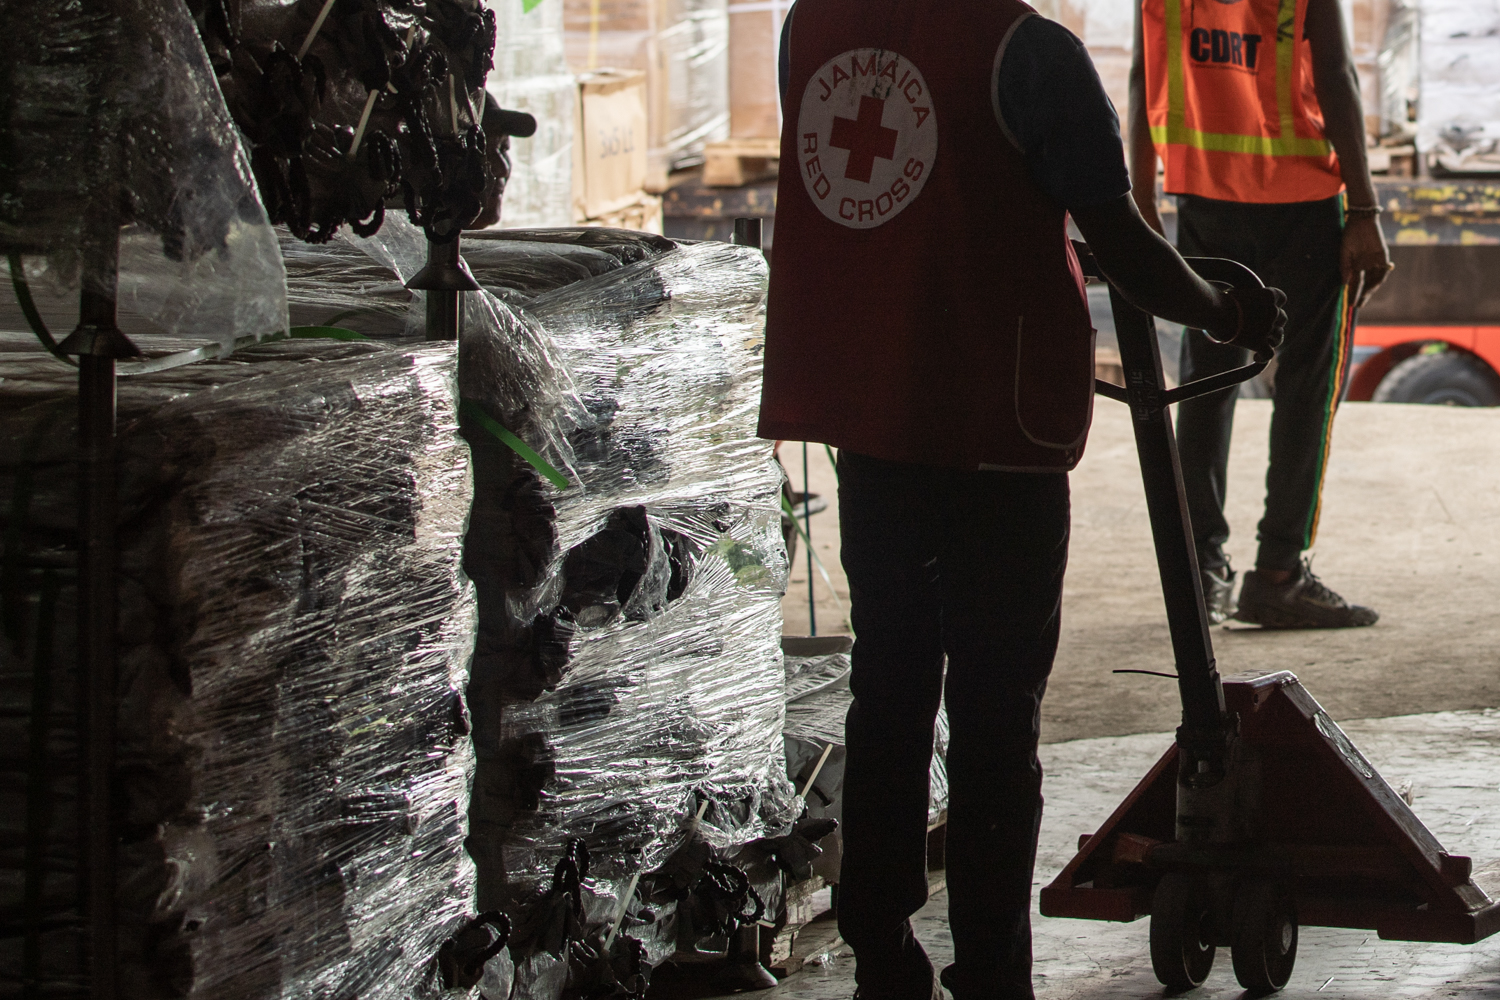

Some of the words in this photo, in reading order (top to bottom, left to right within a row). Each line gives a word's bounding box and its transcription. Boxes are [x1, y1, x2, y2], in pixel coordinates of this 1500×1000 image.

[1190, 27, 1262, 69] CDRT
[820, 54, 930, 129] JAMAICA
[803, 132, 831, 200] RED
[838, 157, 924, 222] CROSS
